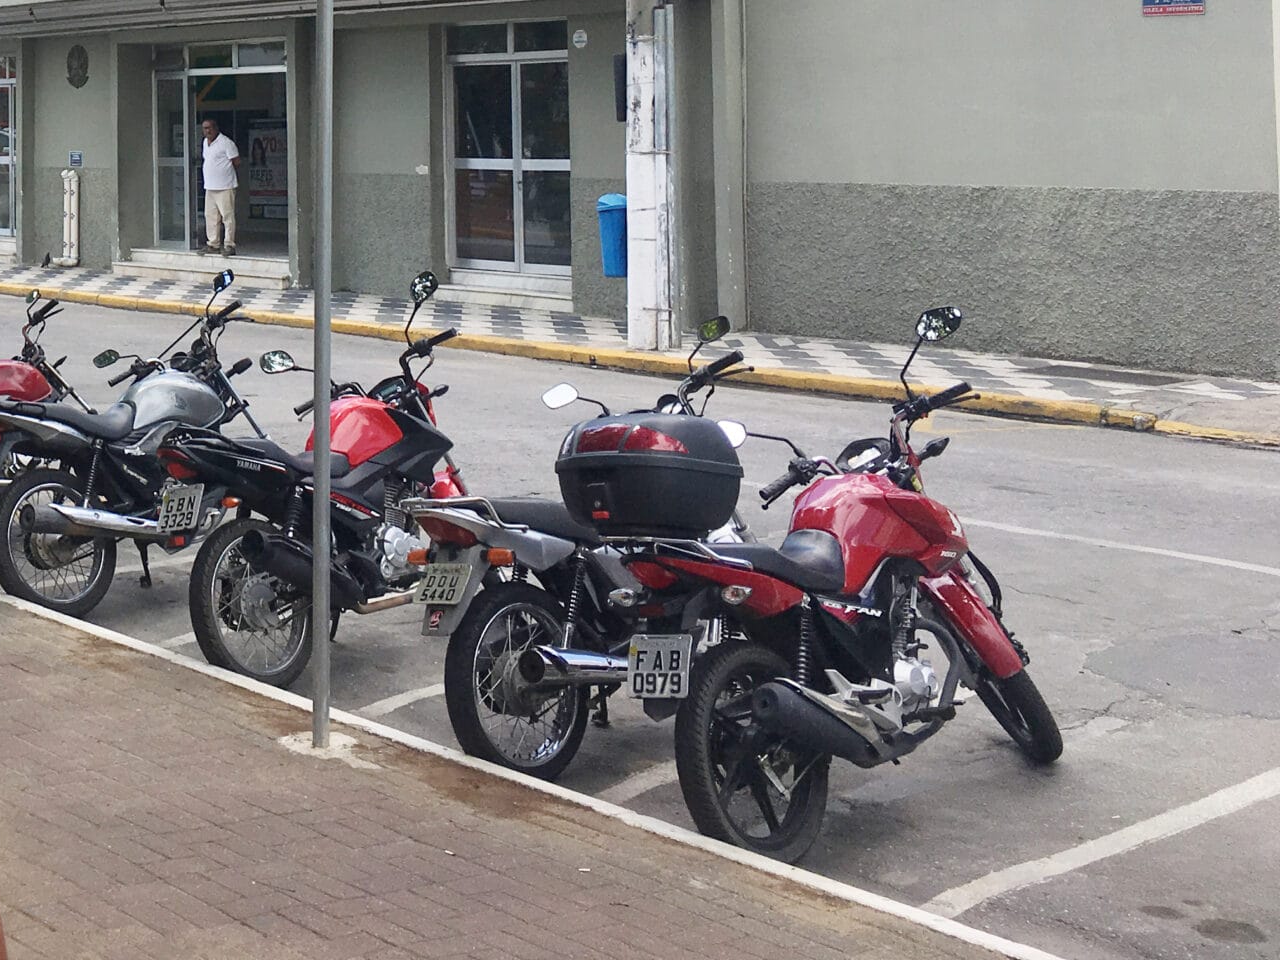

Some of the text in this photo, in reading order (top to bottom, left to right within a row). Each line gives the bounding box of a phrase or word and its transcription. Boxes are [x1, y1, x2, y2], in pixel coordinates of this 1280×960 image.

[236, 459, 261, 472] YAMAHA
[160, 511, 194, 529] 3329
[420, 588, 455, 601] 5440
[844, 604, 883, 618] FAN
[635, 650, 681, 671] FAB
[632, 672, 682, 694] 0979
